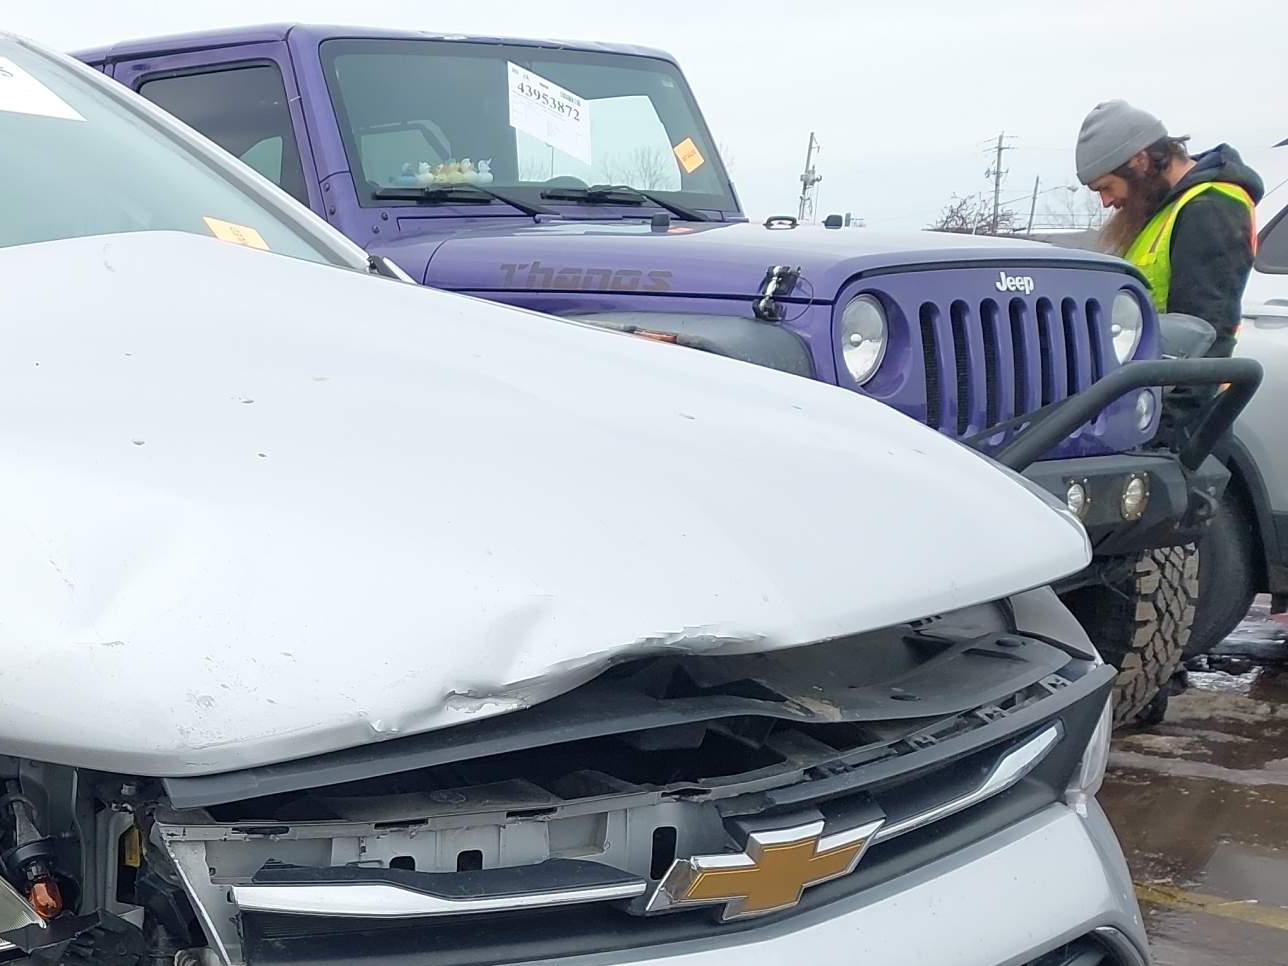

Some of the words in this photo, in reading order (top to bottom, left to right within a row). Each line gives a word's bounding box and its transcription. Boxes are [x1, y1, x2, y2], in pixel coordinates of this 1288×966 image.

[517, 81, 581, 122] 43953872
[500, 261, 673, 291] Thanos
[996, 271, 1035, 295] Jeep
